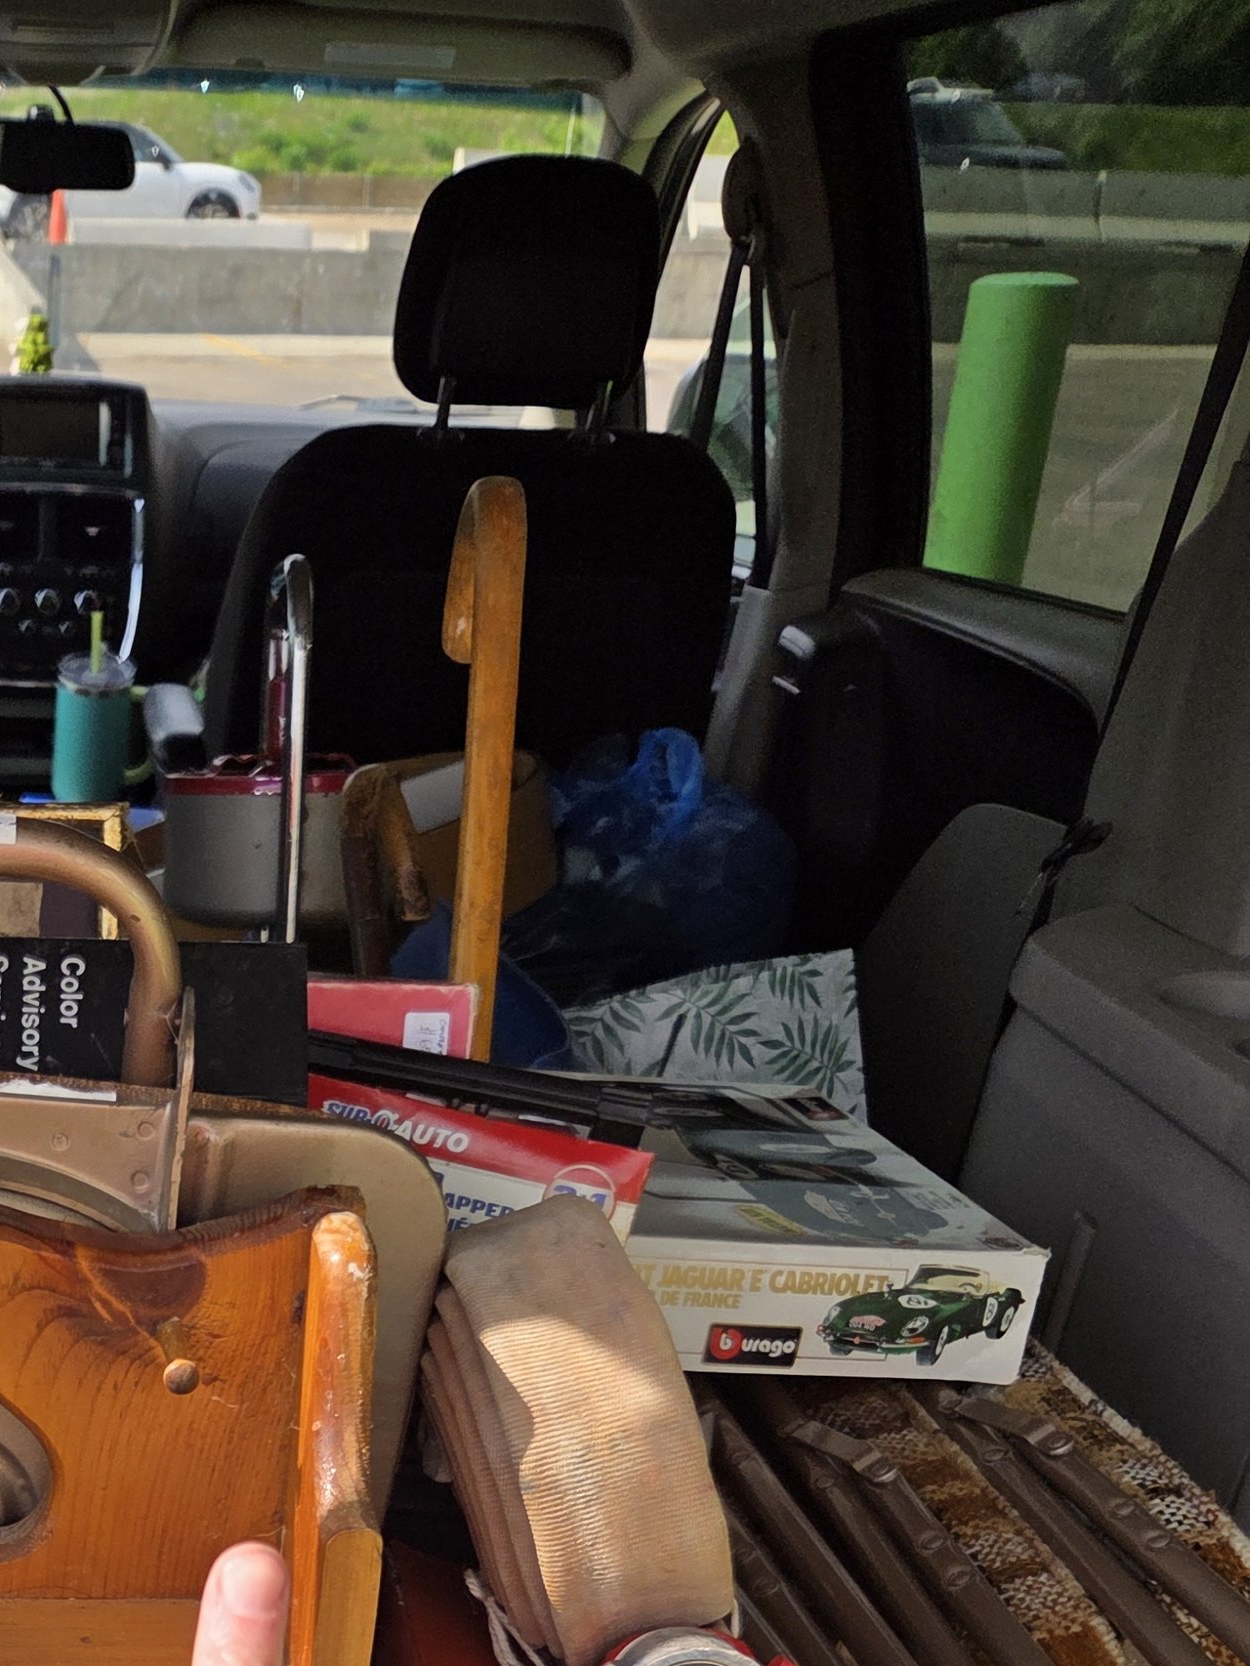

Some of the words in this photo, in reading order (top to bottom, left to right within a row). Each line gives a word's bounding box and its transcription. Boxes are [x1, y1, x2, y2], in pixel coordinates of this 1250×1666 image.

[15, 955, 48, 1072] Advisory
[58, 954, 87, 1029] Color
[658, 1265, 744, 1294] JAGUAR
[747, 1269, 762, 1291] E
[768, 1269, 890, 1298] CABRIOLET
[682, 1291, 741, 1310] FRANCE
